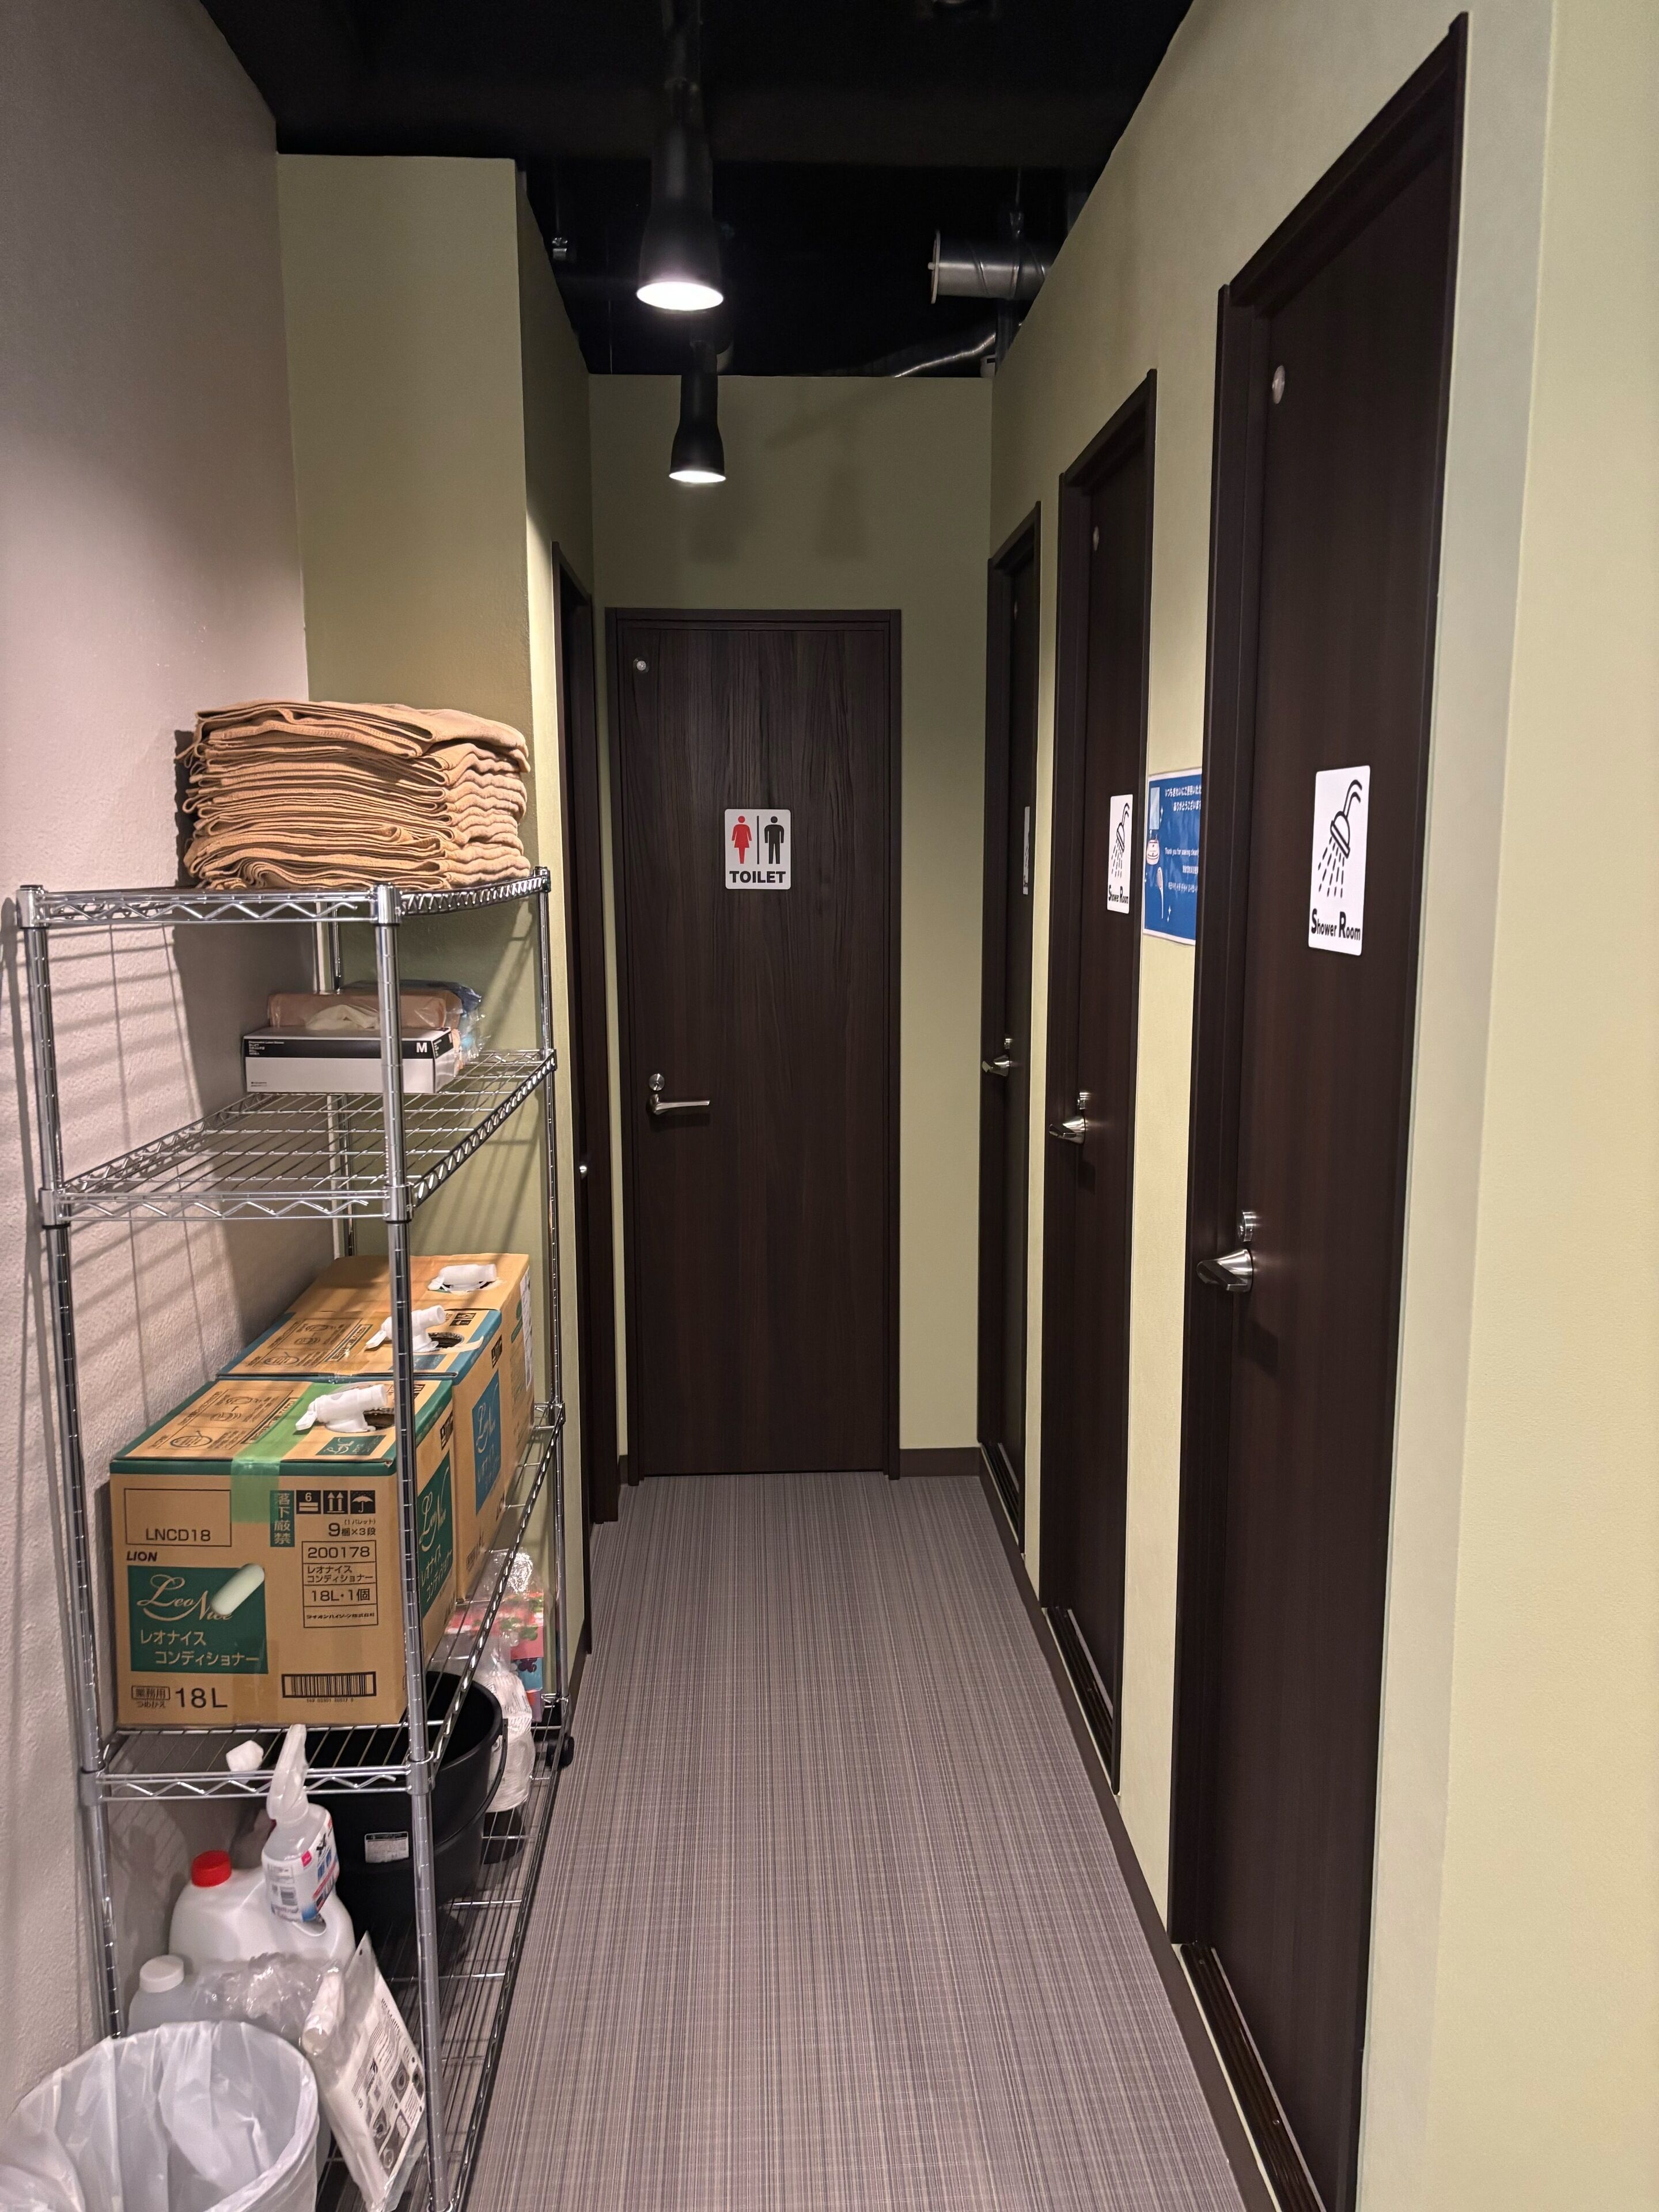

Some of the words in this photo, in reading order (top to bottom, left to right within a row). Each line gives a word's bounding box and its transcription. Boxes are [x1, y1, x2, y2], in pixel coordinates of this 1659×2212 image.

[729, 870, 786, 884] TOILET
[1108, 884, 1119, 902] Shower
[1119, 886, 1128, 904] Room
[1311, 908, 1337, 937] Shower
[1339, 911, 1361, 941] Room
[416, 1042, 427, 1053] M
[305, 1492, 312, 1502] 6
[274, 1492, 291, 1545] 落下厳禁
[145, 1528, 211, 1542] LNCD18
[126, 1551, 158, 1562] LION
[307, 1546, 370, 1559] 200178
[307, 1565, 353, 1575] レオナイス
[307, 1574, 373, 1584] コンディショナー
[140, 1630, 206, 1646] レオナイス
[154, 1651, 260, 1666] コンディショナー
